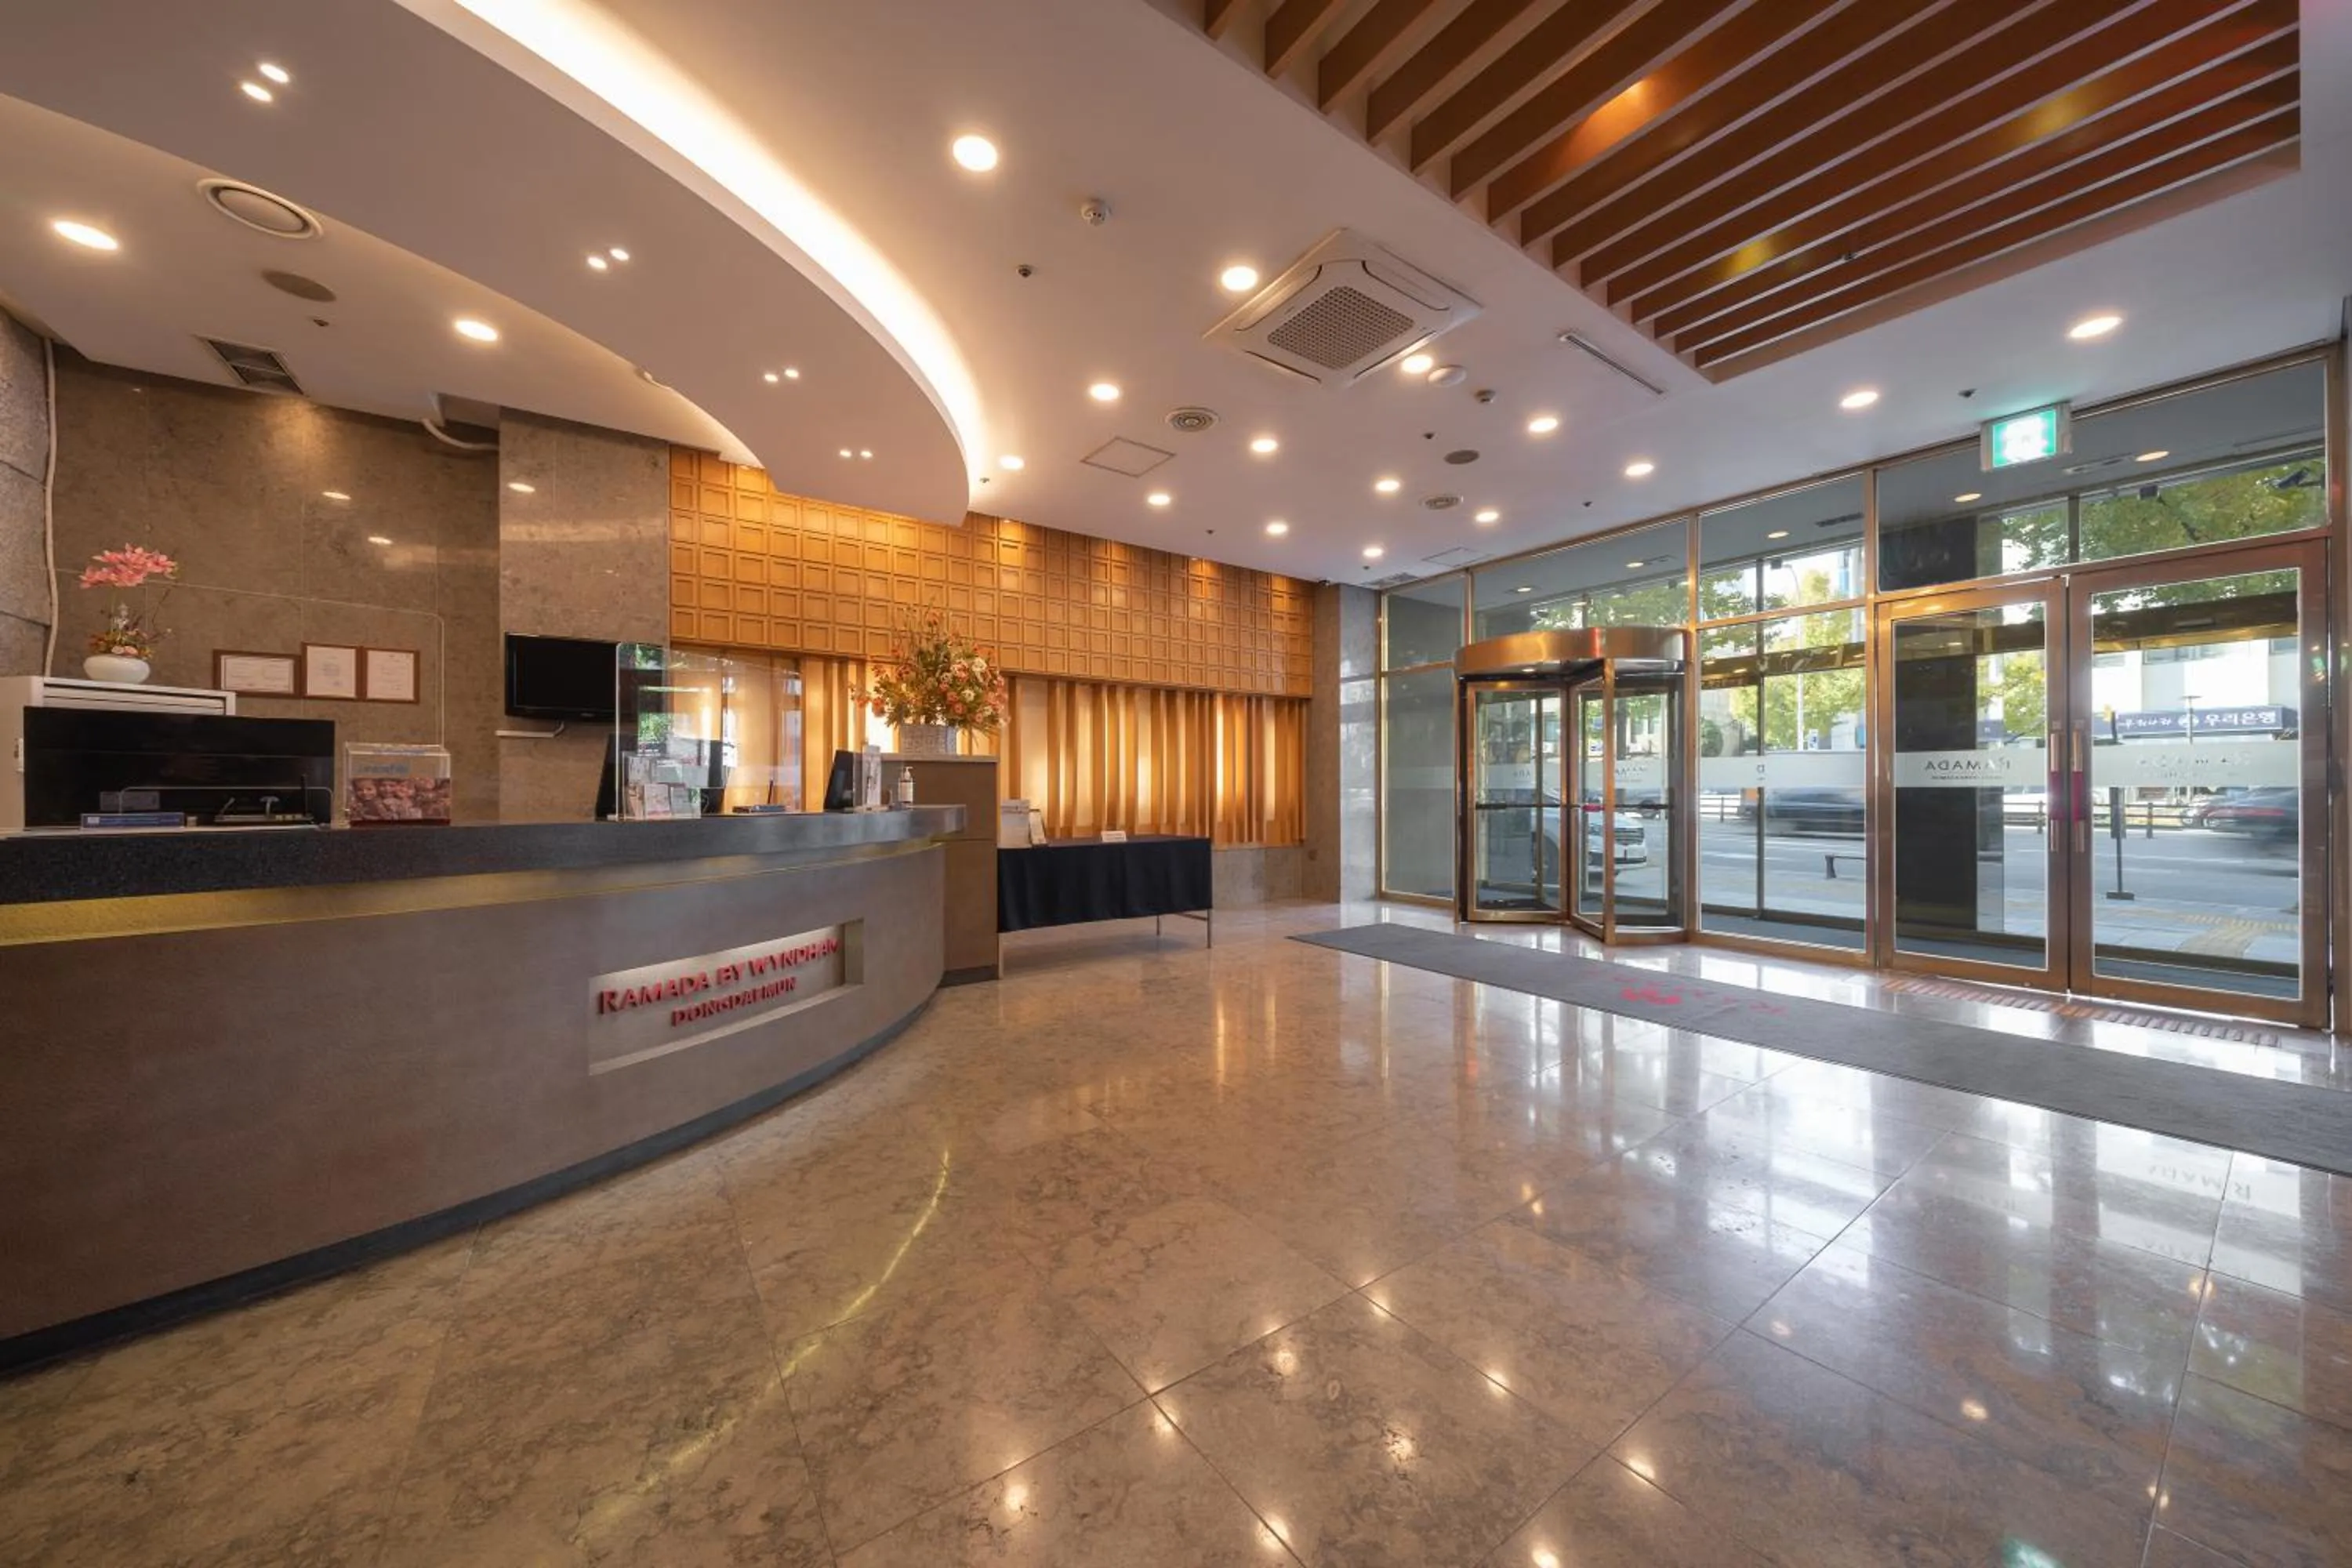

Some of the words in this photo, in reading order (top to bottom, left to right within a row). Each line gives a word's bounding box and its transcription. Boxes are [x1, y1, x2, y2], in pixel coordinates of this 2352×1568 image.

[2205, 711, 2277, 727] 우리은행
[598, 973, 710, 1015] RAMADA
[717, 963, 745, 985] BY
[747, 938, 841, 977] WYNDHAM
[670, 976, 798, 1026] DONGDAEMUN
